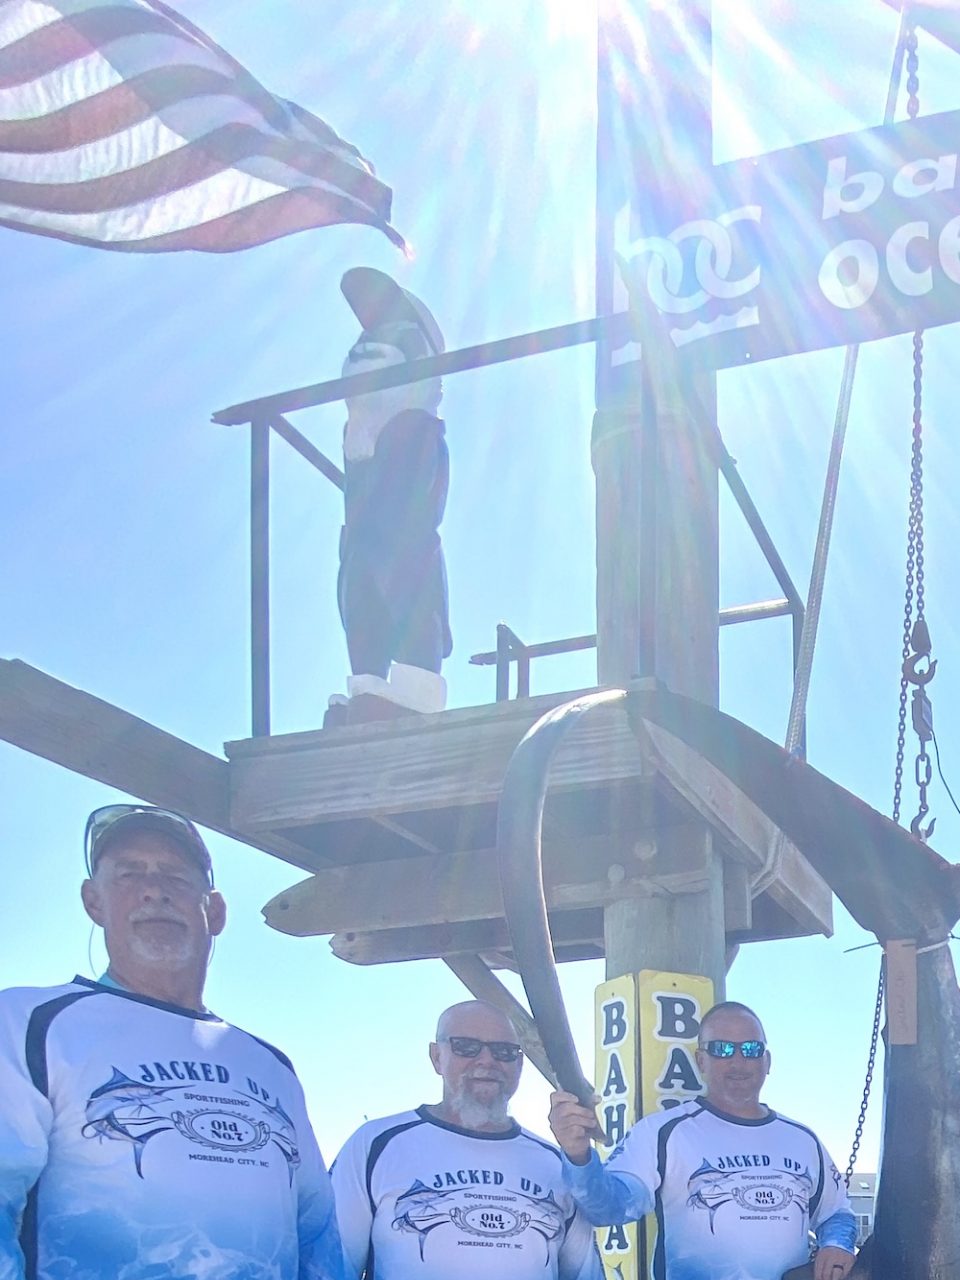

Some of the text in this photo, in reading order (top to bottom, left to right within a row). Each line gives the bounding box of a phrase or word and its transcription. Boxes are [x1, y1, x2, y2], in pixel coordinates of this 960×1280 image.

[138, 1060, 271, 1102] JACKED UP
[184, 1092, 250, 1107] SPORTFISHING
[211, 1119, 238, 1133] Old
[211, 1130, 243, 1142] No.7
[188, 1153, 235, 1164] MOREHEAD
[718, 1154, 802, 1172] JACKED UP
[433, 1169, 543, 1196] JACKED UP
[463, 1192, 517, 1202] SPORTFISHING
[754, 1197, 776, 1205] No.7
[480, 1213, 503, 1222] Old
[479, 1220, 505, 1230] No.7
